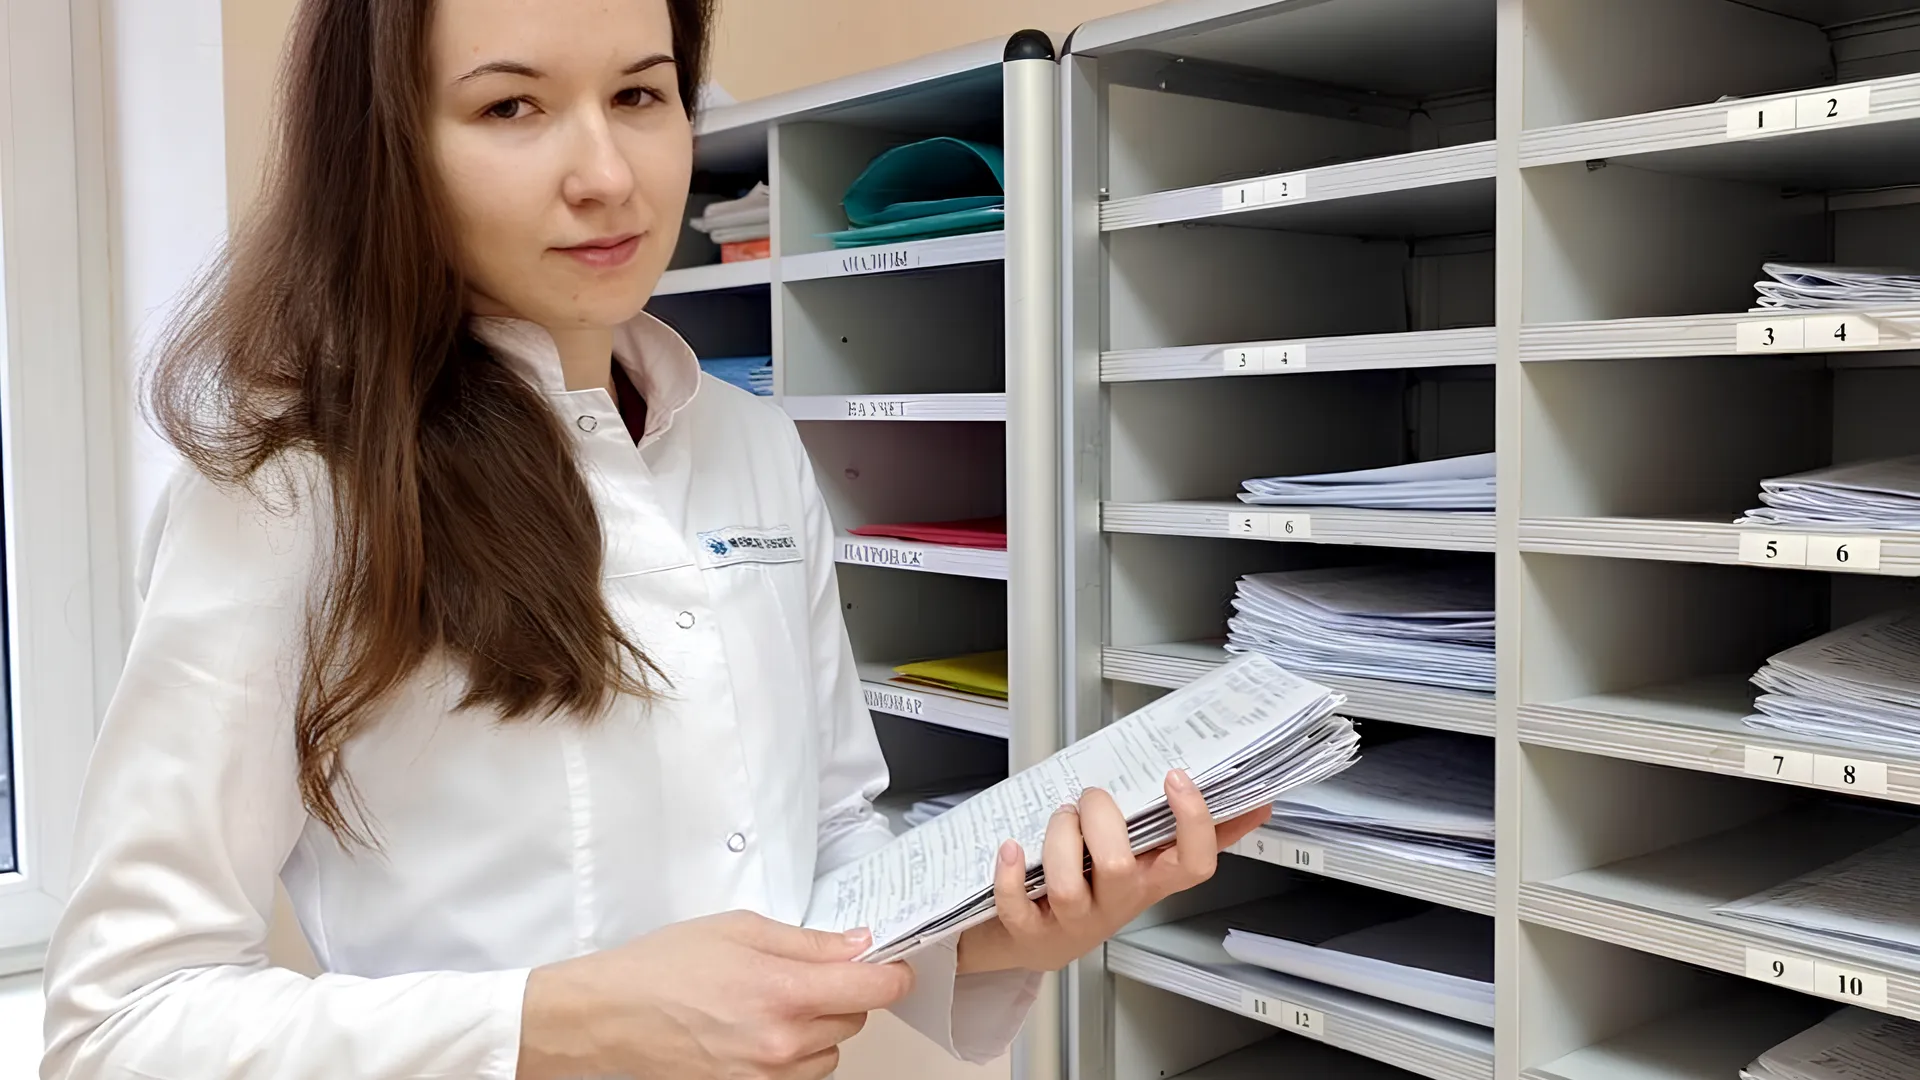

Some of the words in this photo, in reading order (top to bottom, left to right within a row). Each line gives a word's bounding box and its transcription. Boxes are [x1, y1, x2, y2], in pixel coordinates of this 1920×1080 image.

[1758, 110, 1764, 129] 1
[1826, 98, 1838, 118] 2
[1281, 182, 1288, 197] 2
[1763, 327, 1775, 346] 3
[1833, 323, 1847, 342] 4
[1239, 352, 1247, 368] 3
[1280, 351, 1288, 365] 4
[1243, 518, 1252, 533] 5
[1285, 520, 1294, 534] 6
[1765, 540, 1778, 559] 5
[1836, 544, 1849, 563] 6
[1773, 755, 1784, 775] 7
[1843, 765, 1856, 785] 8
[1295, 849, 1310, 866] 10
[1772, 960, 1785, 978] 9
[1838, 975, 1863, 997] 10
[1254, 999, 1267, 1015] 11
[1295, 1011, 1310, 1028] 12
